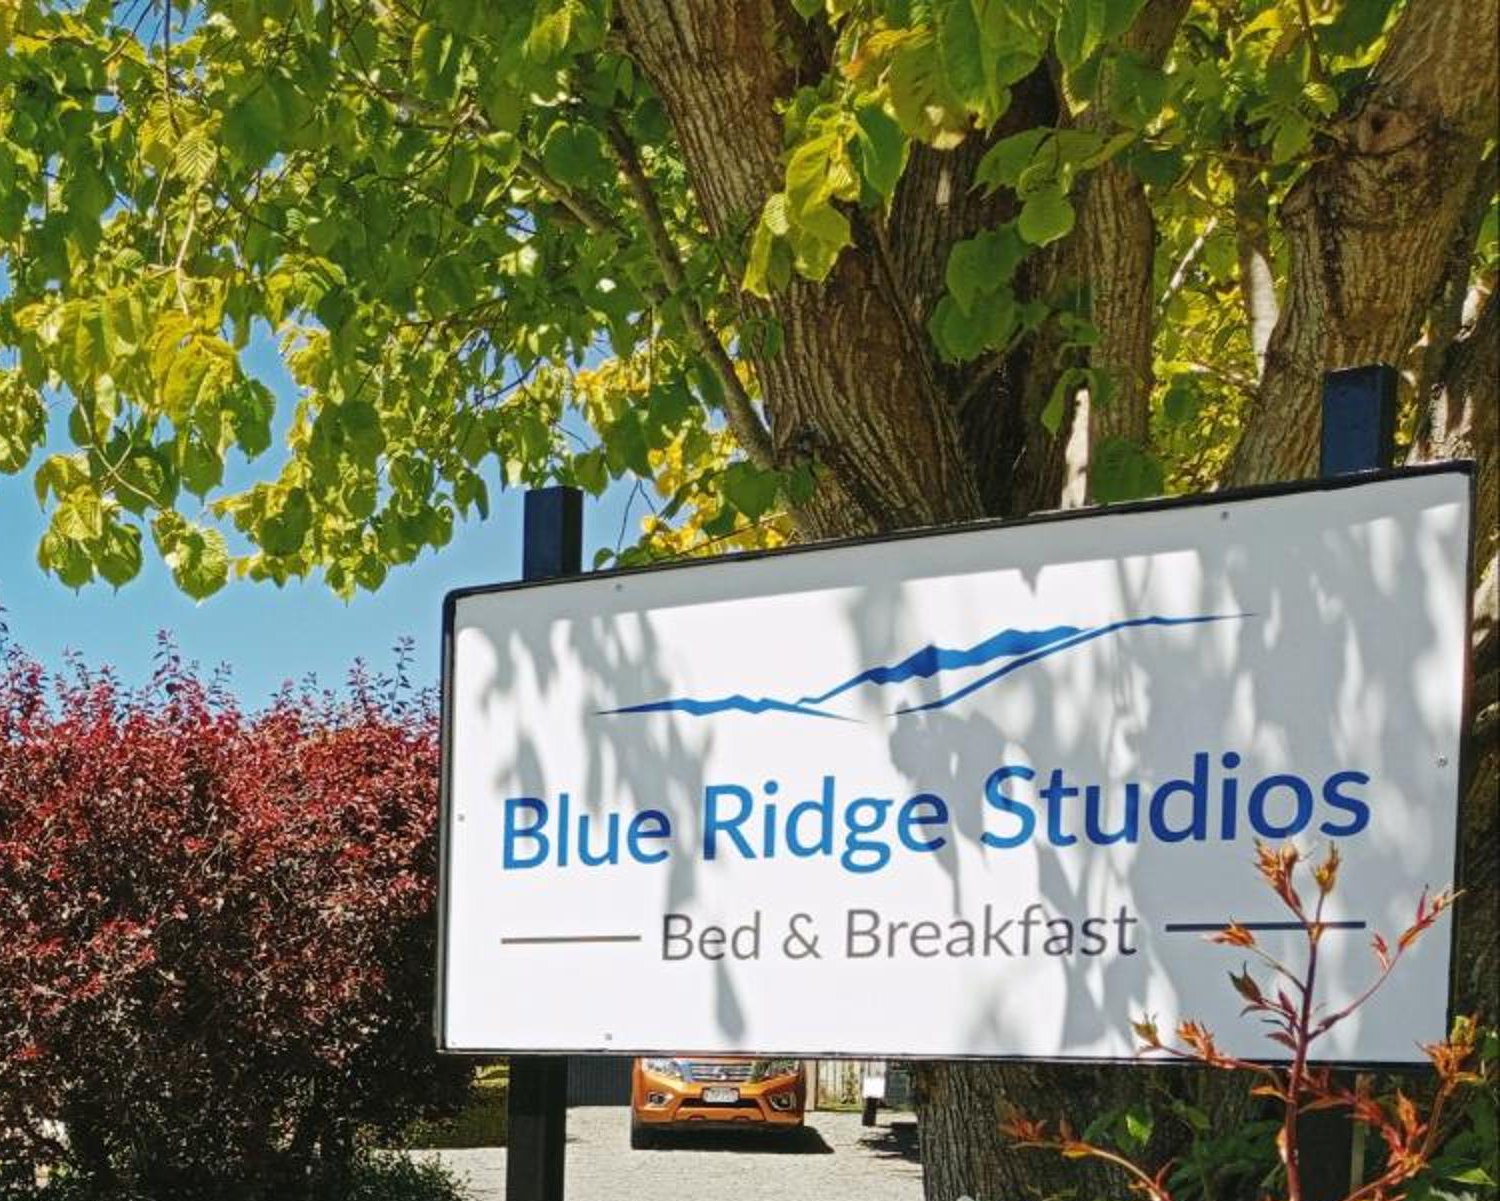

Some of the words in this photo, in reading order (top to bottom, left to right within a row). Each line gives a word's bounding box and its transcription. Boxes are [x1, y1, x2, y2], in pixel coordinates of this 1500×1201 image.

[502, 793, 670, 869] Blue
[703, 775, 949, 873] Ridge
[980, 751, 1371, 850] Studios
[661, 909, 761, 961] Bed
[782, 912, 822, 961] &
[845, 903, 1137, 958] Breakfast
